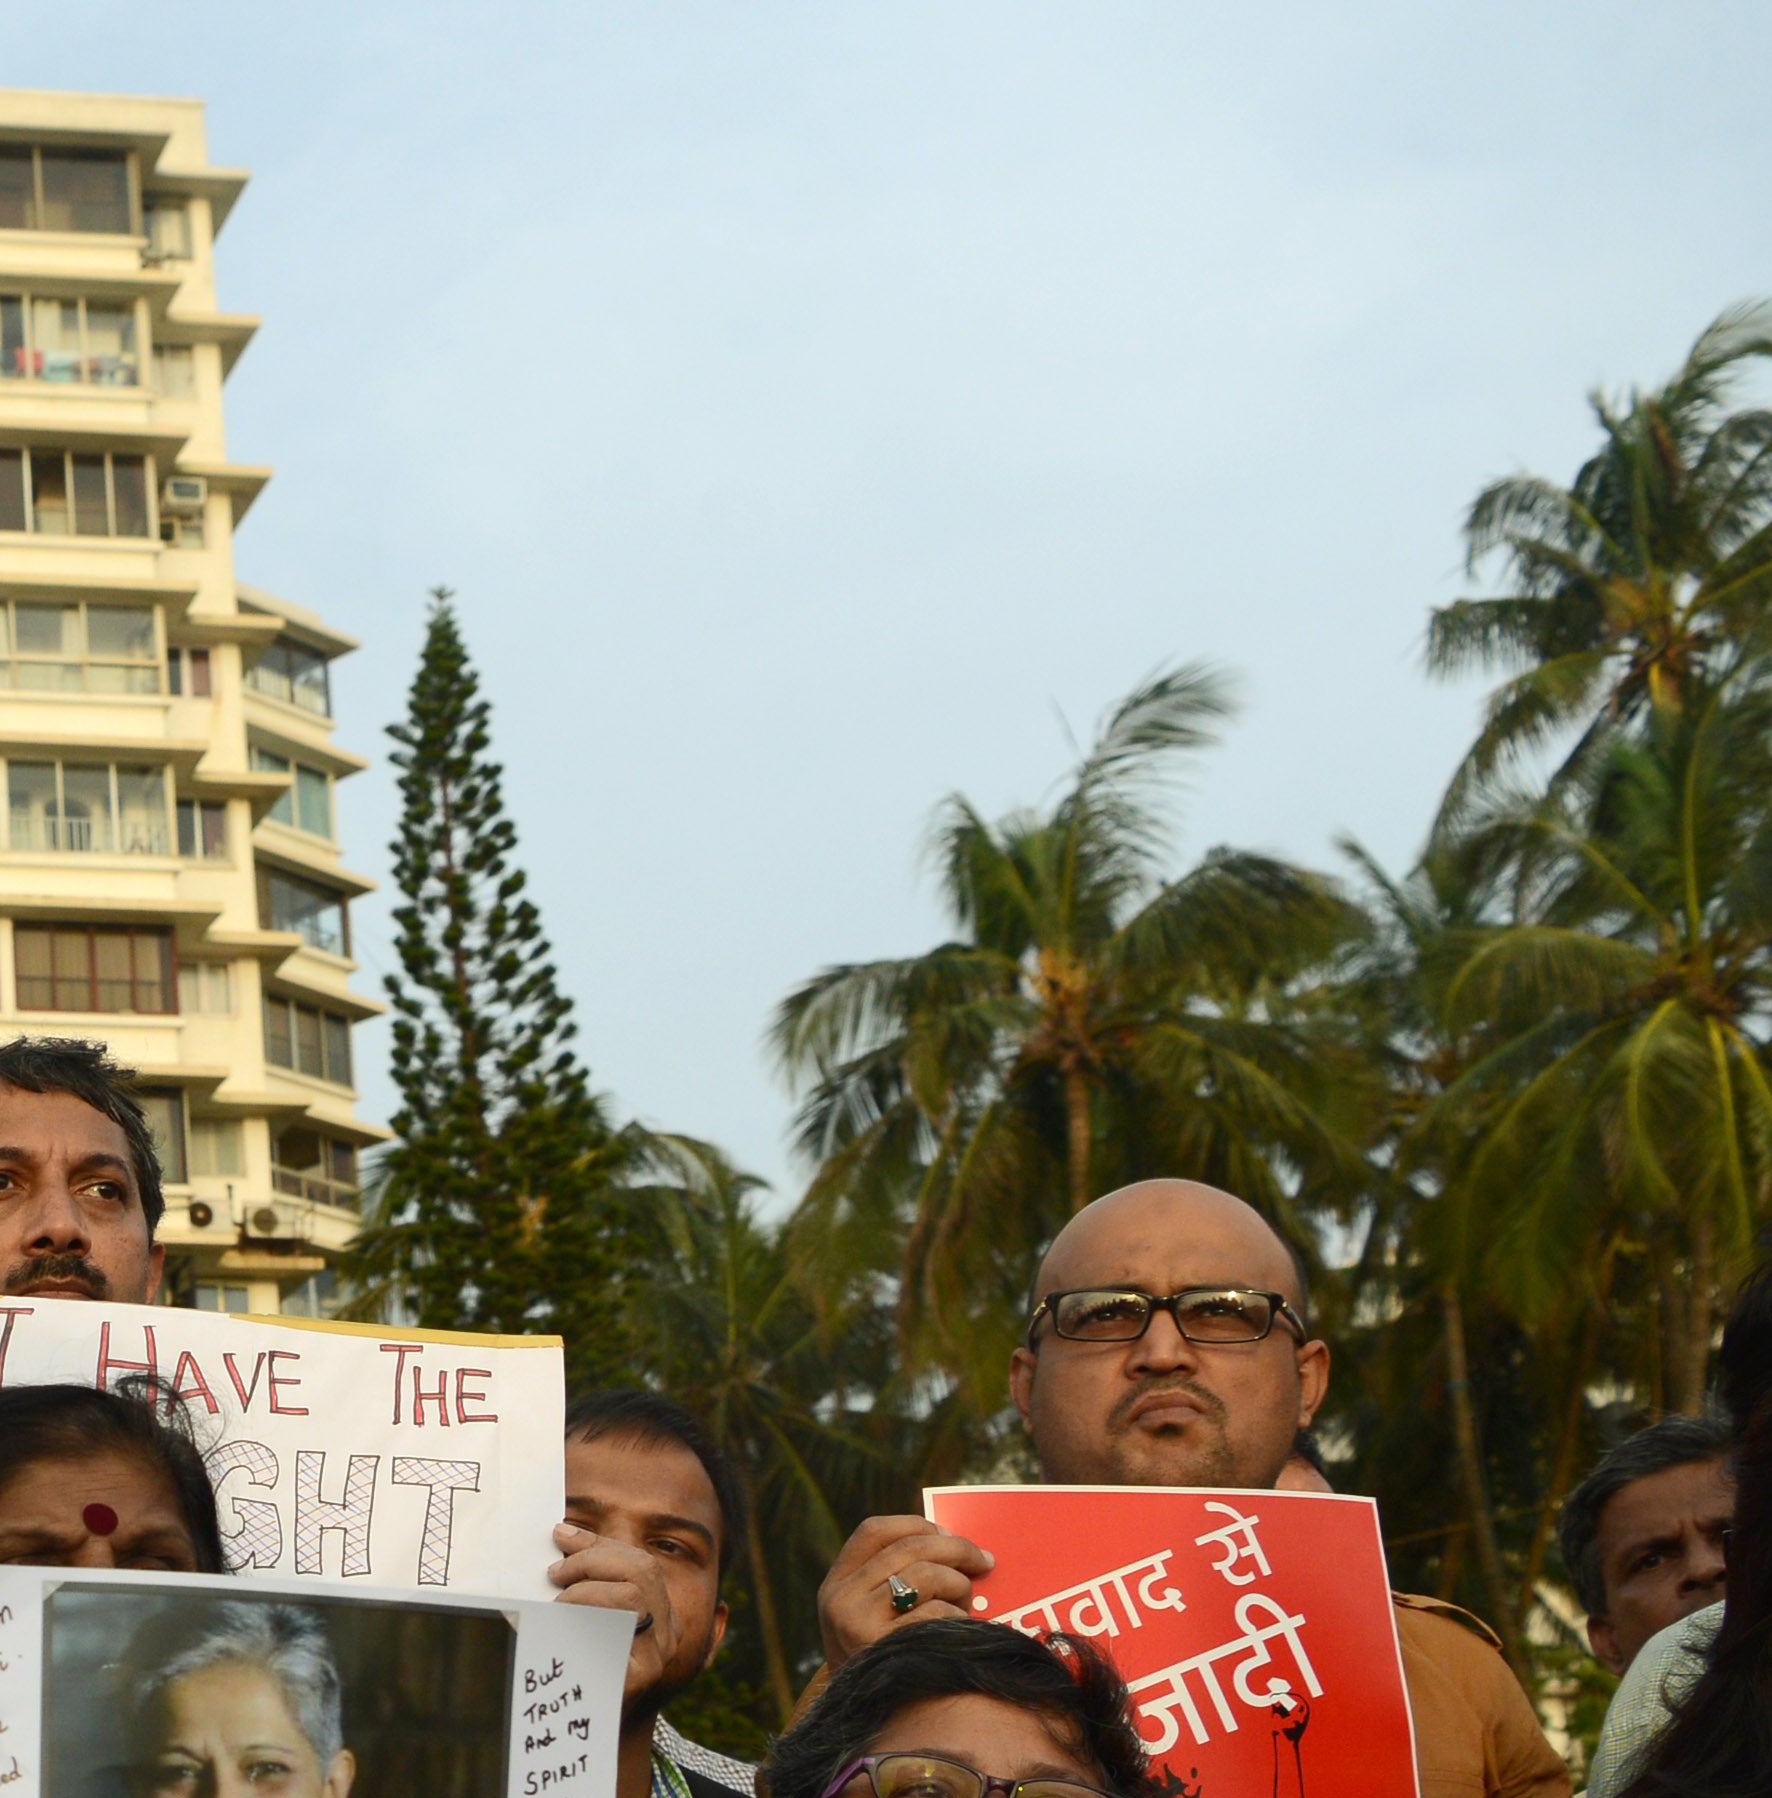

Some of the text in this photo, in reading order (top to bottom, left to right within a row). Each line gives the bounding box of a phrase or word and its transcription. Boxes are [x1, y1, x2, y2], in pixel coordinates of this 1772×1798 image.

[96, 1320, 309, 1416] HAVE
[379, 1344, 499, 1427] THE
[1195, 1501, 1272, 1586] से
[525, 1658, 564, 1692] But
[524, 1684, 582, 1724] TRUTH
[568, 1718, 590, 1740] my
[524, 1754, 588, 1795] SPIRIT
